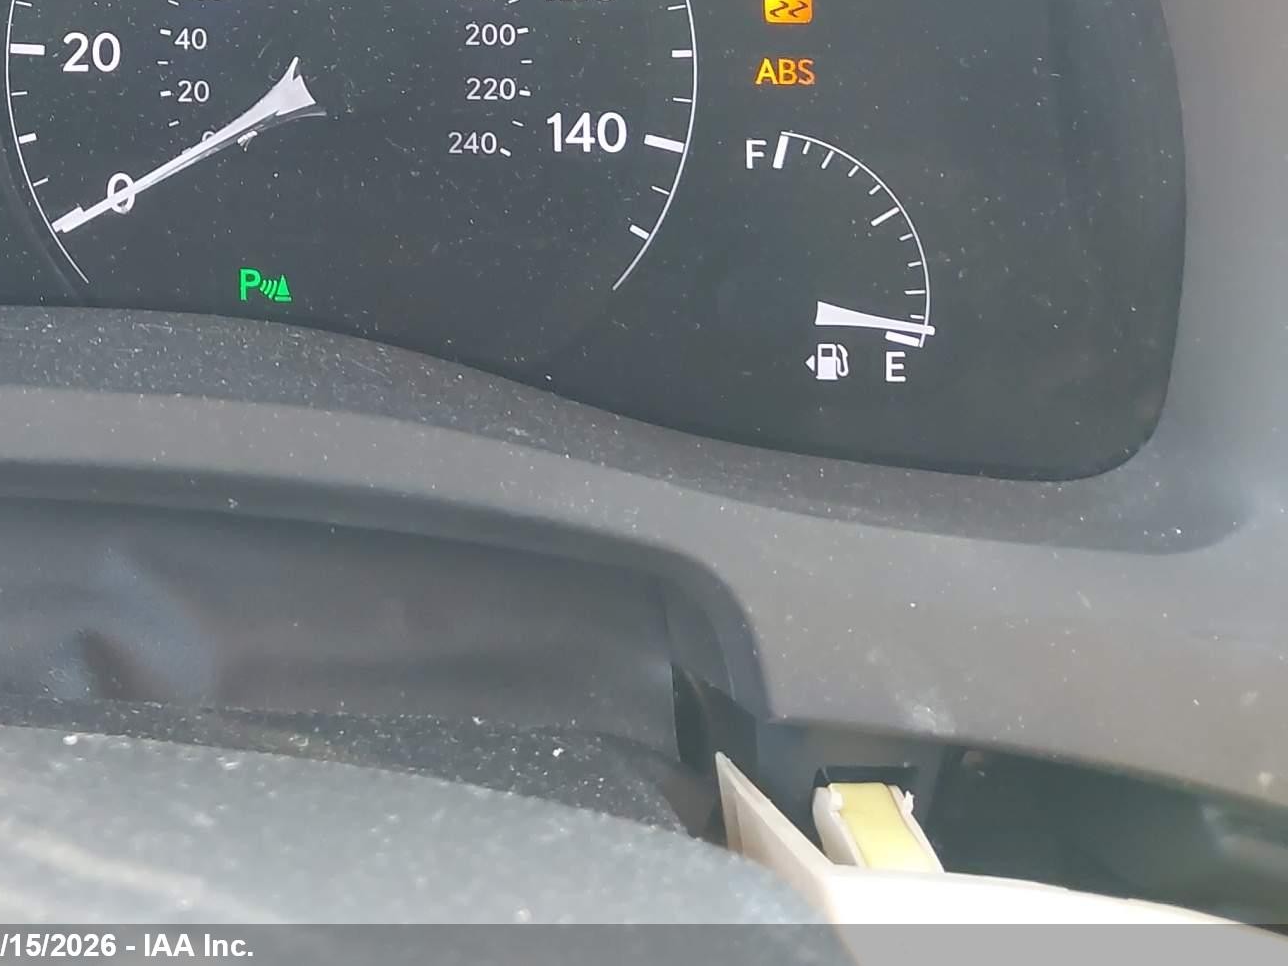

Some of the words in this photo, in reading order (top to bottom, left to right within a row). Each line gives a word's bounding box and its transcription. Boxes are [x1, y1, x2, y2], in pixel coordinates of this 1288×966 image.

[174, 28, 207, 52] 40
[465, 24, 516, 47] 200
[62, 33, 121, 72] 20
[755, 58, 816, 86] ABS
[177, 80, 209, 103] 20
[466, 77, 515, 101] 220
[448, 132, 497, 154] 240
[547, 113, 627, 153] 140
[745, 139, 767, 169] F
[106, 173, 136, 213] 0
[886, 352, 906, 382] E
